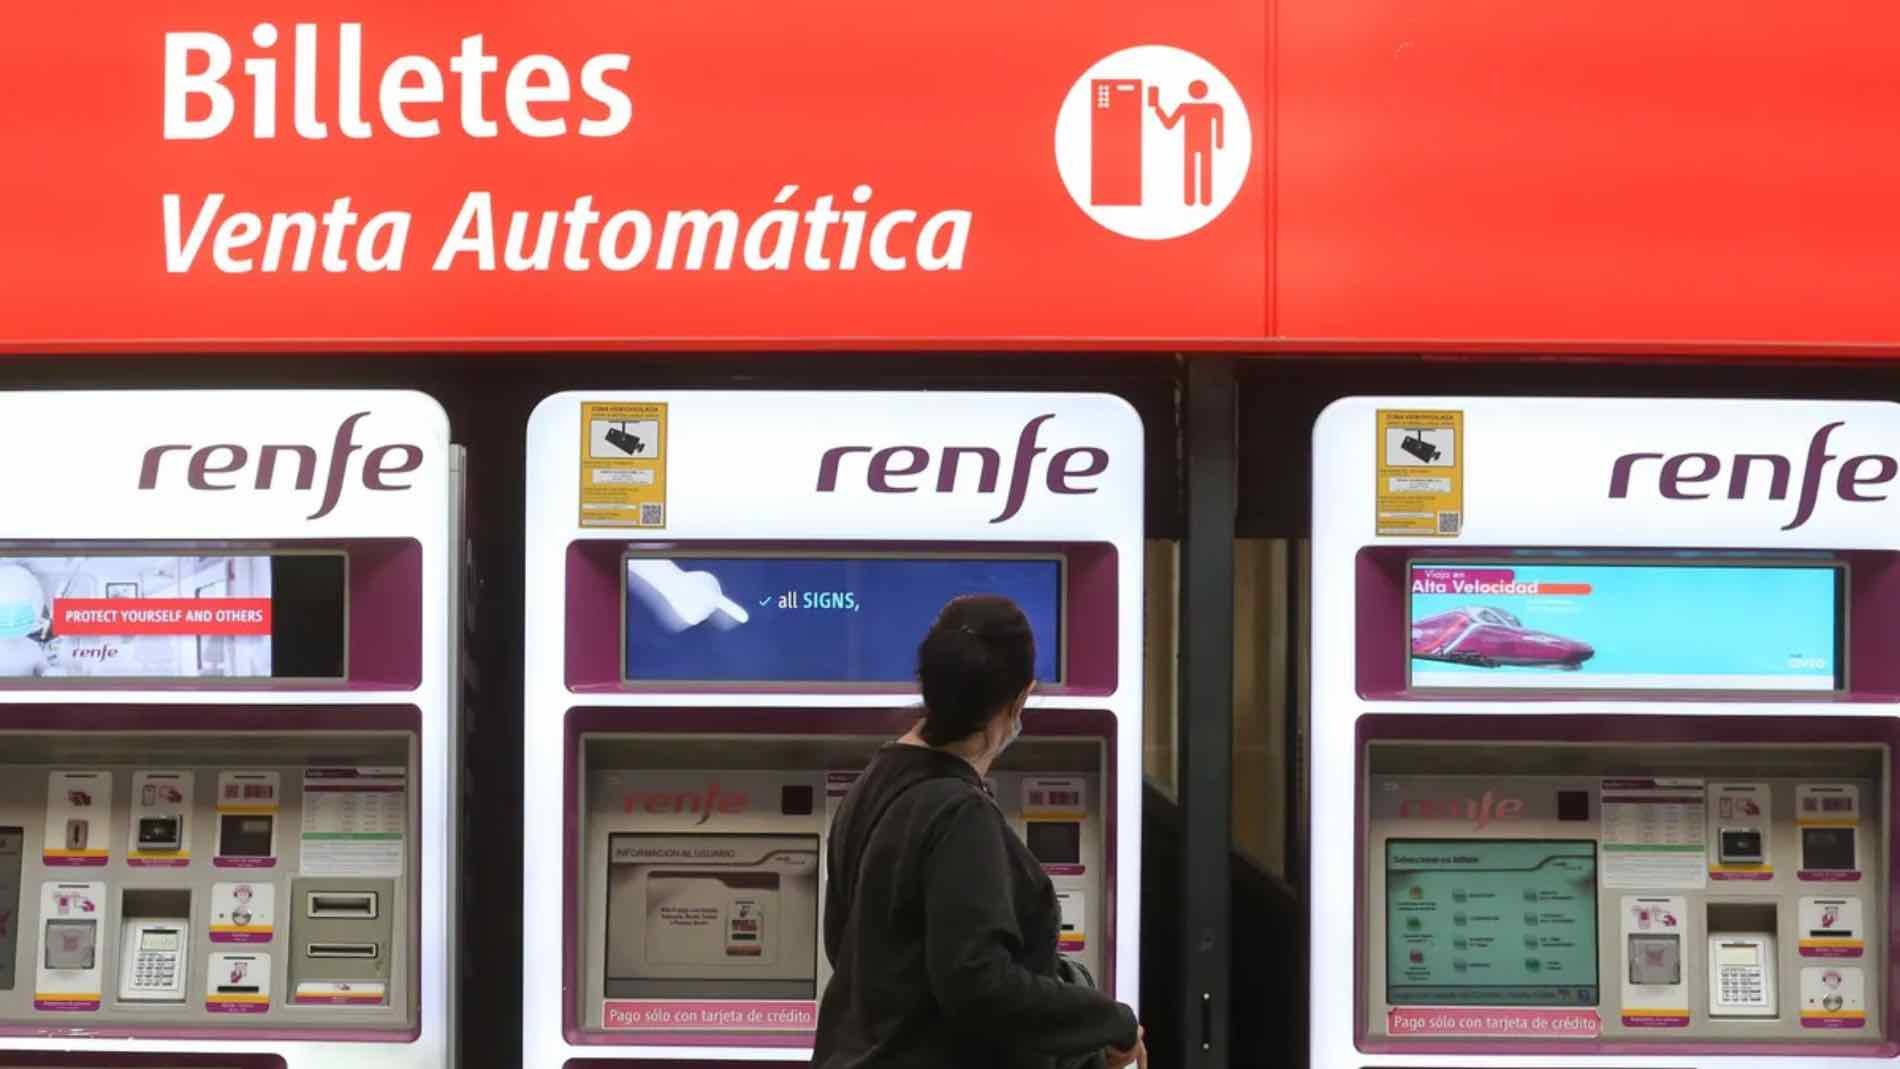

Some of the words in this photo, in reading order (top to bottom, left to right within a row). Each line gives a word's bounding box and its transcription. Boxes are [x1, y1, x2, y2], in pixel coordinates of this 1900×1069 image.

[163, 22, 633, 140] Billetes
[163, 192, 412, 273] Venta
[433, 184, 973, 272] Automática
[138, 411, 424, 521] renfe
[815, 413, 1110, 524] renfe
[1607, 421, 1900, 532] renfe
[778, 591, 798, 609] all
[803, 591, 860, 612] SIGNS,
[1411, 579, 1447, 594] Alta
[1452, 579, 1539, 594] Velocidad
[65, 609, 117, 623] PROTECT
[121, 609, 183, 623] YOURSELF
[185, 609, 213, 623] AND
[215, 609, 264, 623] OTHERS
[71, 645, 119, 662] renfe
[623, 783, 750, 826] renfe
[1396, 791, 1525, 832] renfe
[610, 1008, 641, 1025] Pago
[645, 1007, 671, 1023] sólo
[674, 1011, 697, 1023] con
[701, 1008, 743, 1025] tarjeta
[747, 1008, 763, 1023] de
[767, 1008, 811, 1023] crédito
[1393, 1014, 1426, 1032] Pago
[1428, 1014, 1456, 1030] sólo
[1458, 1017, 1482, 1030] con
[1486, 1015, 1529, 1032] tarjeta
[1531, 1015, 1549, 1030] de
[1551, 1015, 1597, 1031] crédito
